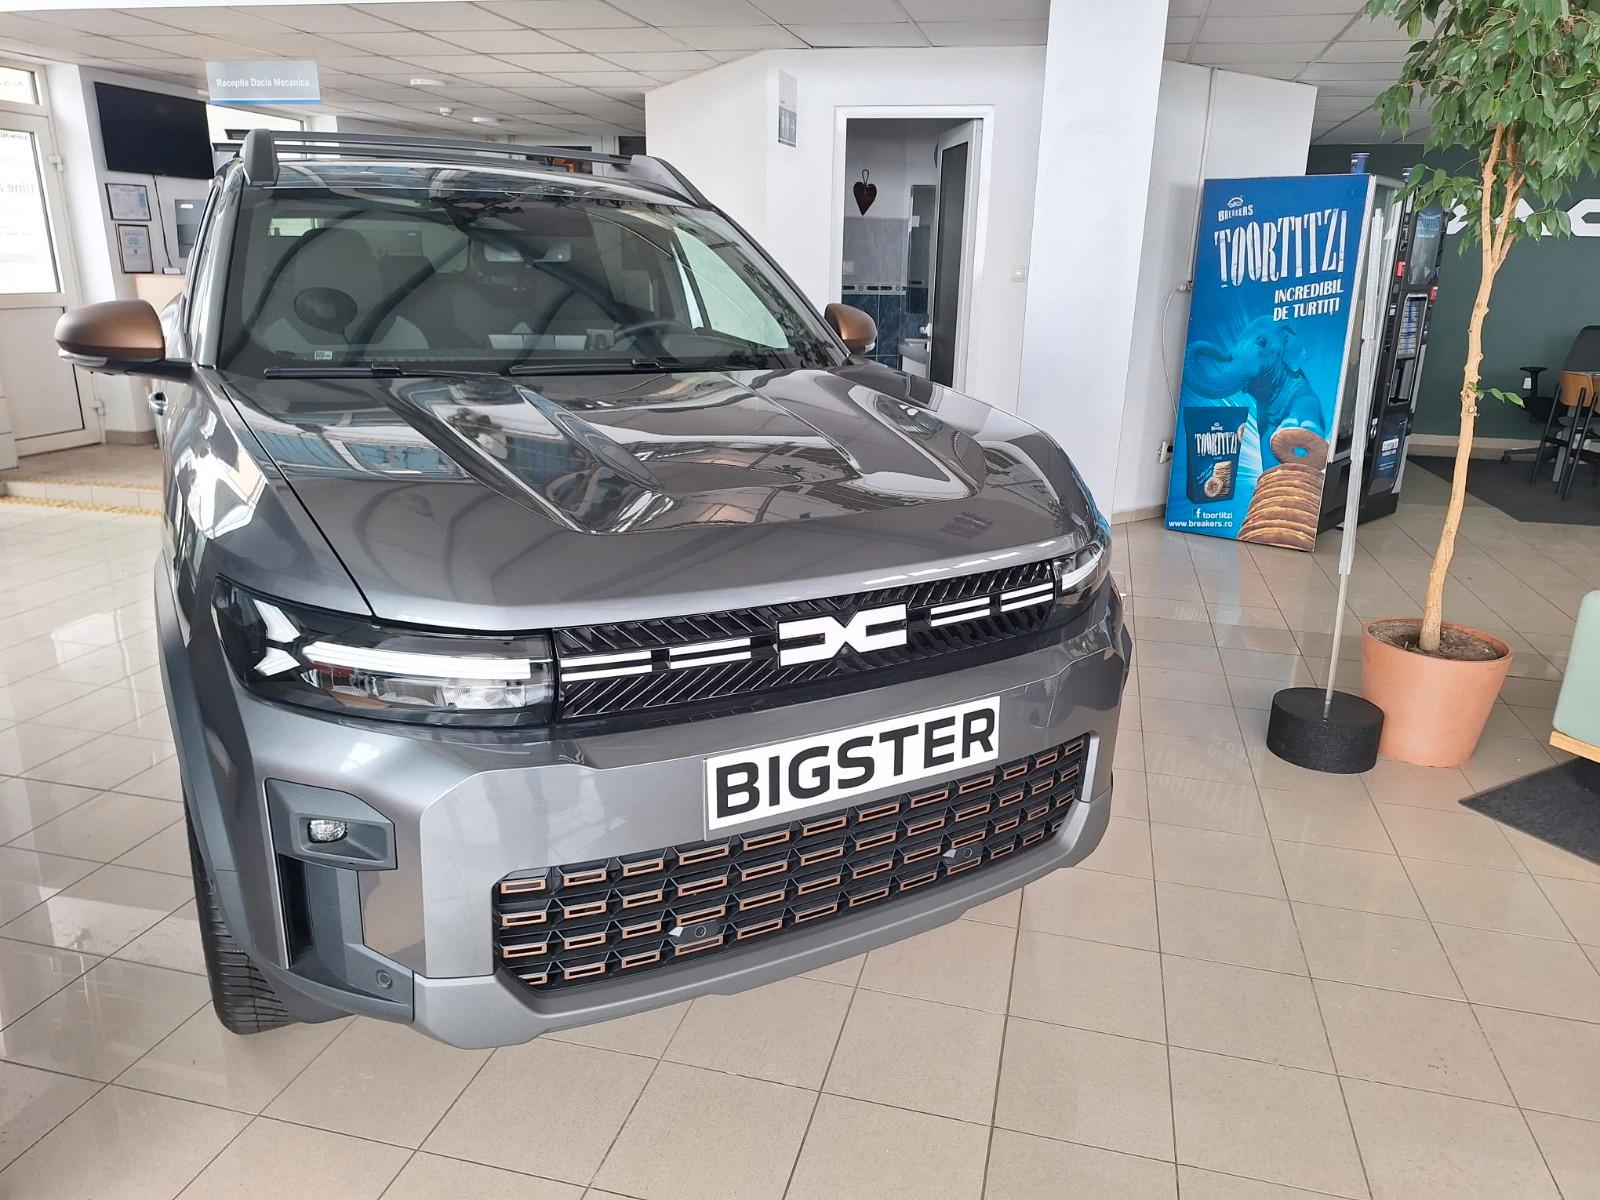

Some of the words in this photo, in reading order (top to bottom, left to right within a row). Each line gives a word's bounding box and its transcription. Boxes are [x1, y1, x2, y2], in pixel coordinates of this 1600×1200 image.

[251, 78, 272, 87] Dacia
[1218, 204, 1254, 221] BREAKERS
[1214, 208, 1348, 288] TOORTITZI
[1274, 279, 1344, 304] INCREDIBIL
[1273, 306, 1290, 322] DE
[1202, 511, 1233, 519] toortitzi
[1168, 519, 1233, 528] www.breakers.ro
[716, 708, 996, 819] BIGSTER
